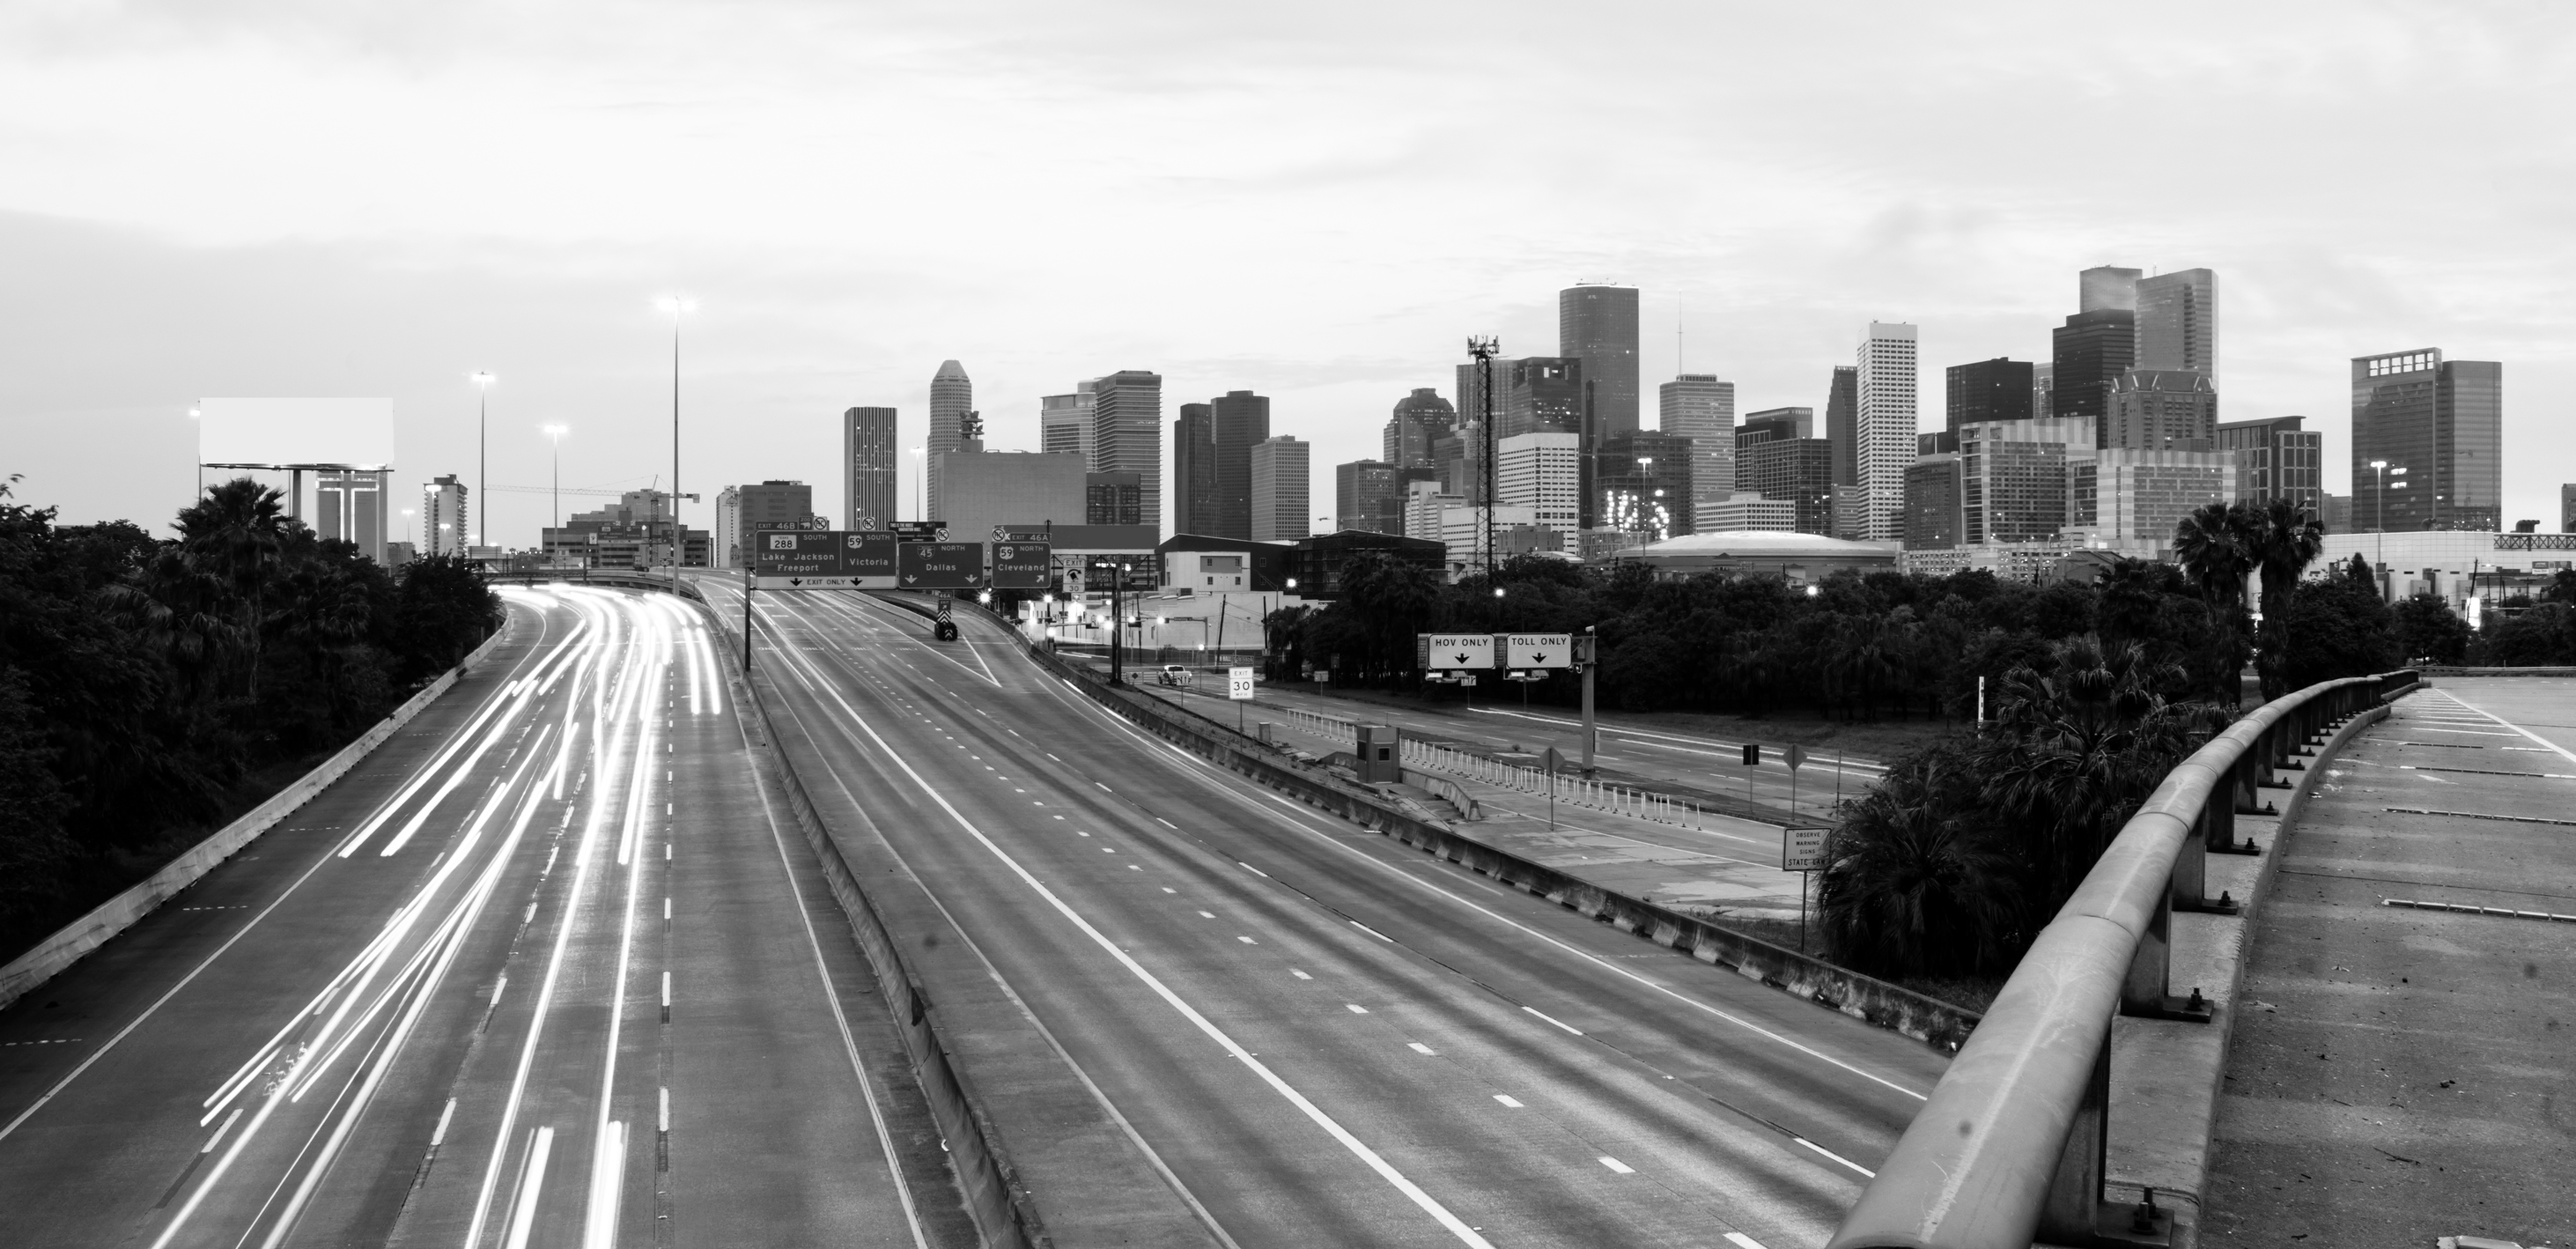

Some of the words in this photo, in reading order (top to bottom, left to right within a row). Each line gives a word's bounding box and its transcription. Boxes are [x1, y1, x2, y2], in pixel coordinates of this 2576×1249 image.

[774, 540, 793, 549] 288
[849, 537, 861, 546] 59
[920, 549, 933, 558] 45
[1000, 549, 1013, 558] 59
[778, 564, 819, 573] Freeport
[1233, 681, 1250, 691] 30
